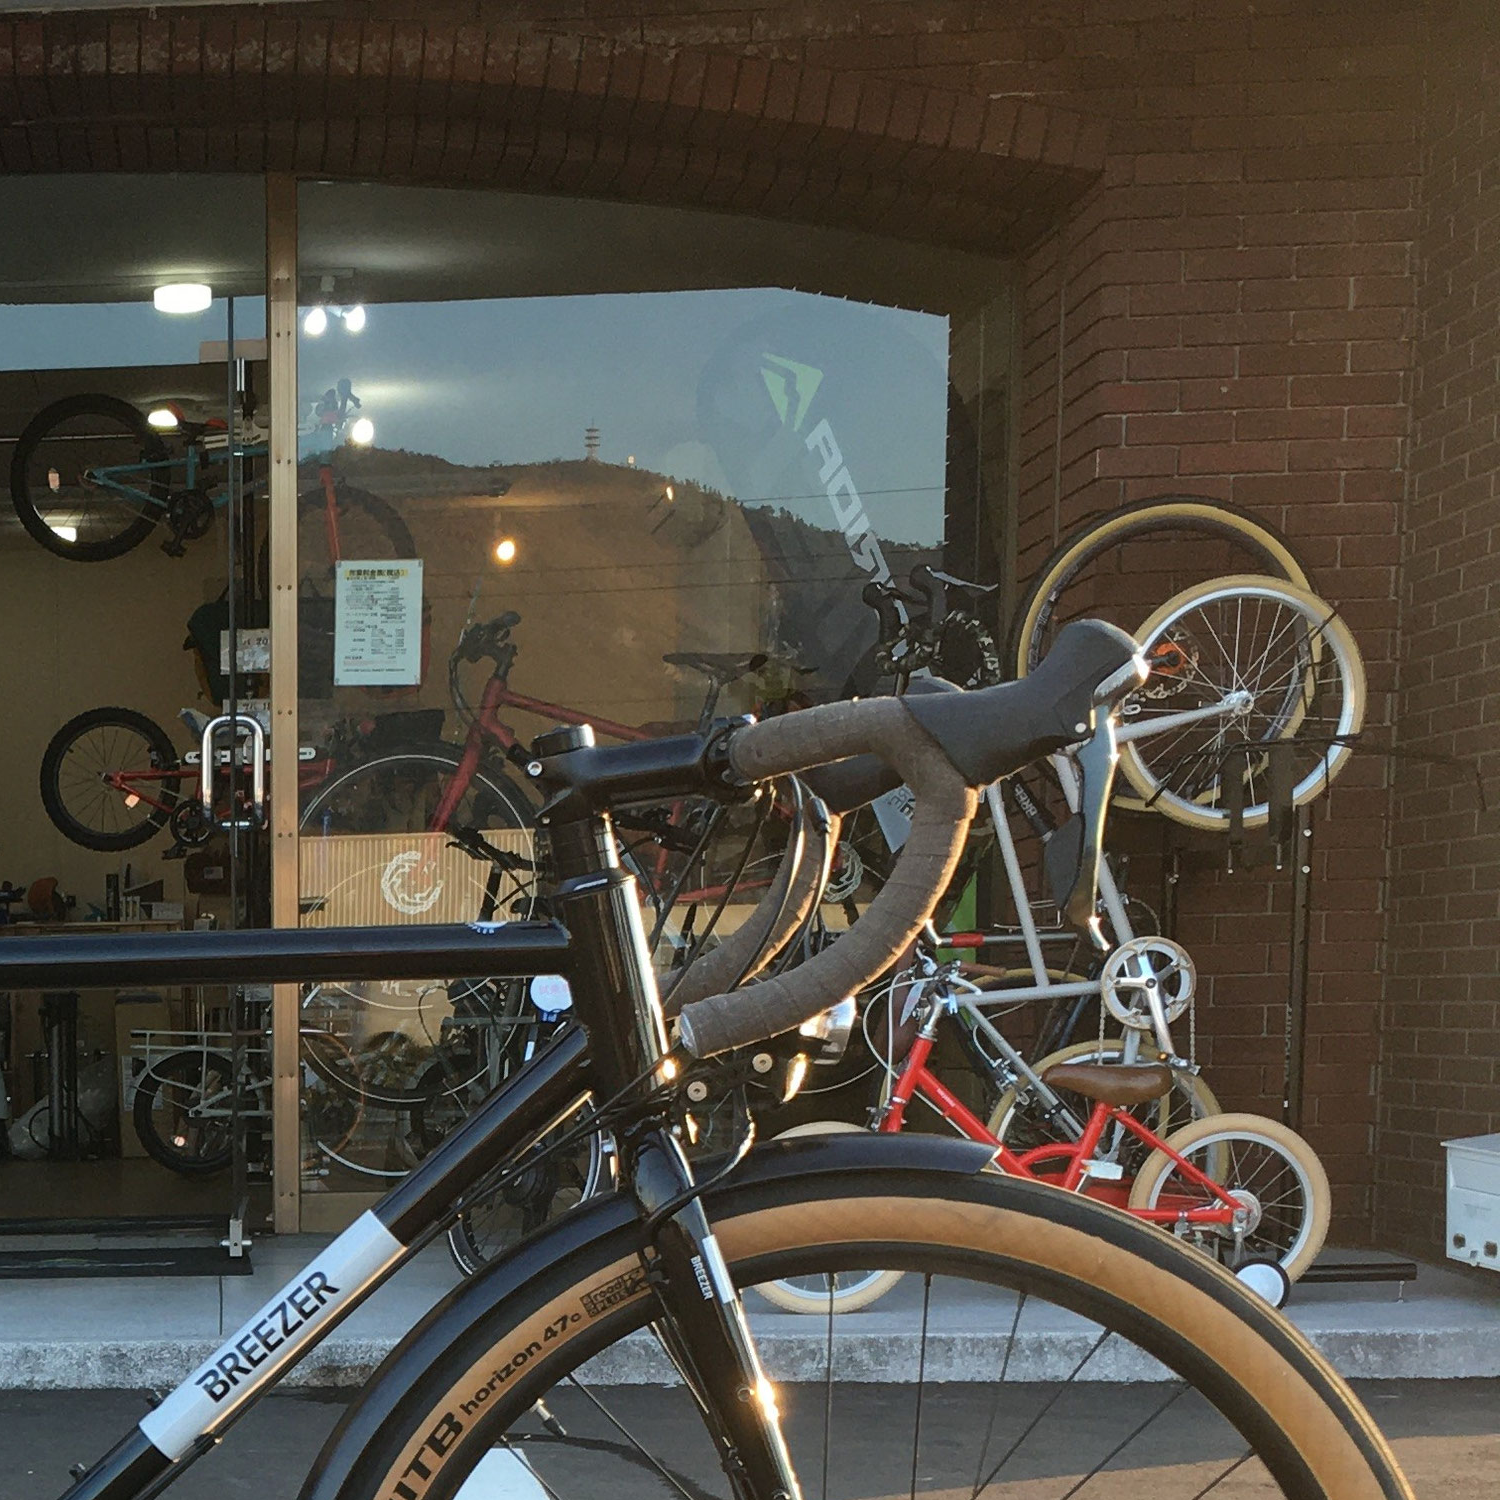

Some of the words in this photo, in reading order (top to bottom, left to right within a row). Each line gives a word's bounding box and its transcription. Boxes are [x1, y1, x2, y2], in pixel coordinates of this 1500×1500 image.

[690, 1254, 715, 1301] BREEZER
[194, 1270, 341, 1404] BREEZER
[460, 1342, 543, 1417] horizon
[543, 1312, 581, 1343] 47c
